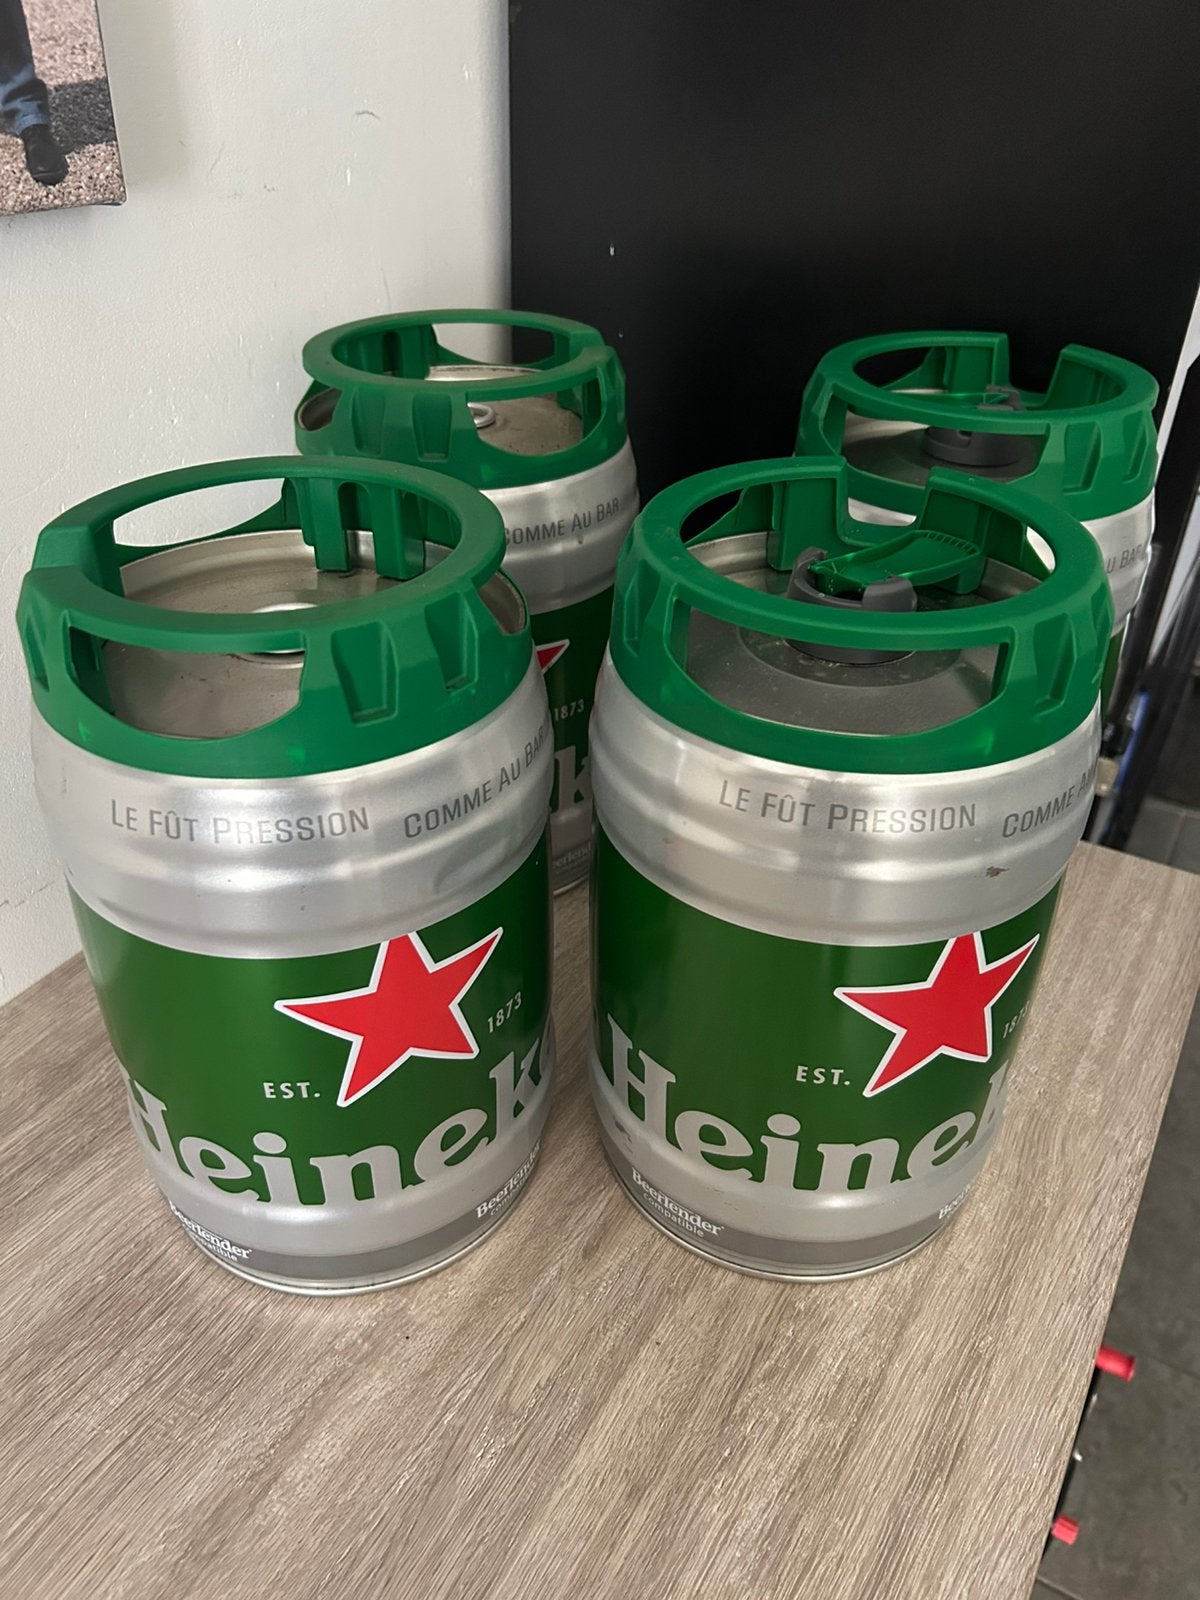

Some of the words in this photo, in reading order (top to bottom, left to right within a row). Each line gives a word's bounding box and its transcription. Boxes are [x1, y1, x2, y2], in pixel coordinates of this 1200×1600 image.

[571, 511, 592, 532] AU
[596, 497, 619, 522] BAR
[1106, 556, 1117, 574] U
[553, 699, 585, 722] 1873
[111, 798, 139, 832] LE
[149, 809, 199, 843] FÛT
[213, 806, 370, 845] PRESSION
[404, 781, 492, 839] COMME
[499, 765, 521, 793] AU
[524, 725, 544, 768] BAR
[719, 779, 752, 813] LE
[761, 792, 816, 827] FÛT
[827, 803, 977, 834] PRESSION
[1002, 785, 1076, 838] COMME
[487, 990, 523, 1034] 1873
[263, 1081, 321, 1100] EST.
[796, 1065, 851, 1087] EST.
[643, 1192, 705, 1239] compatible
